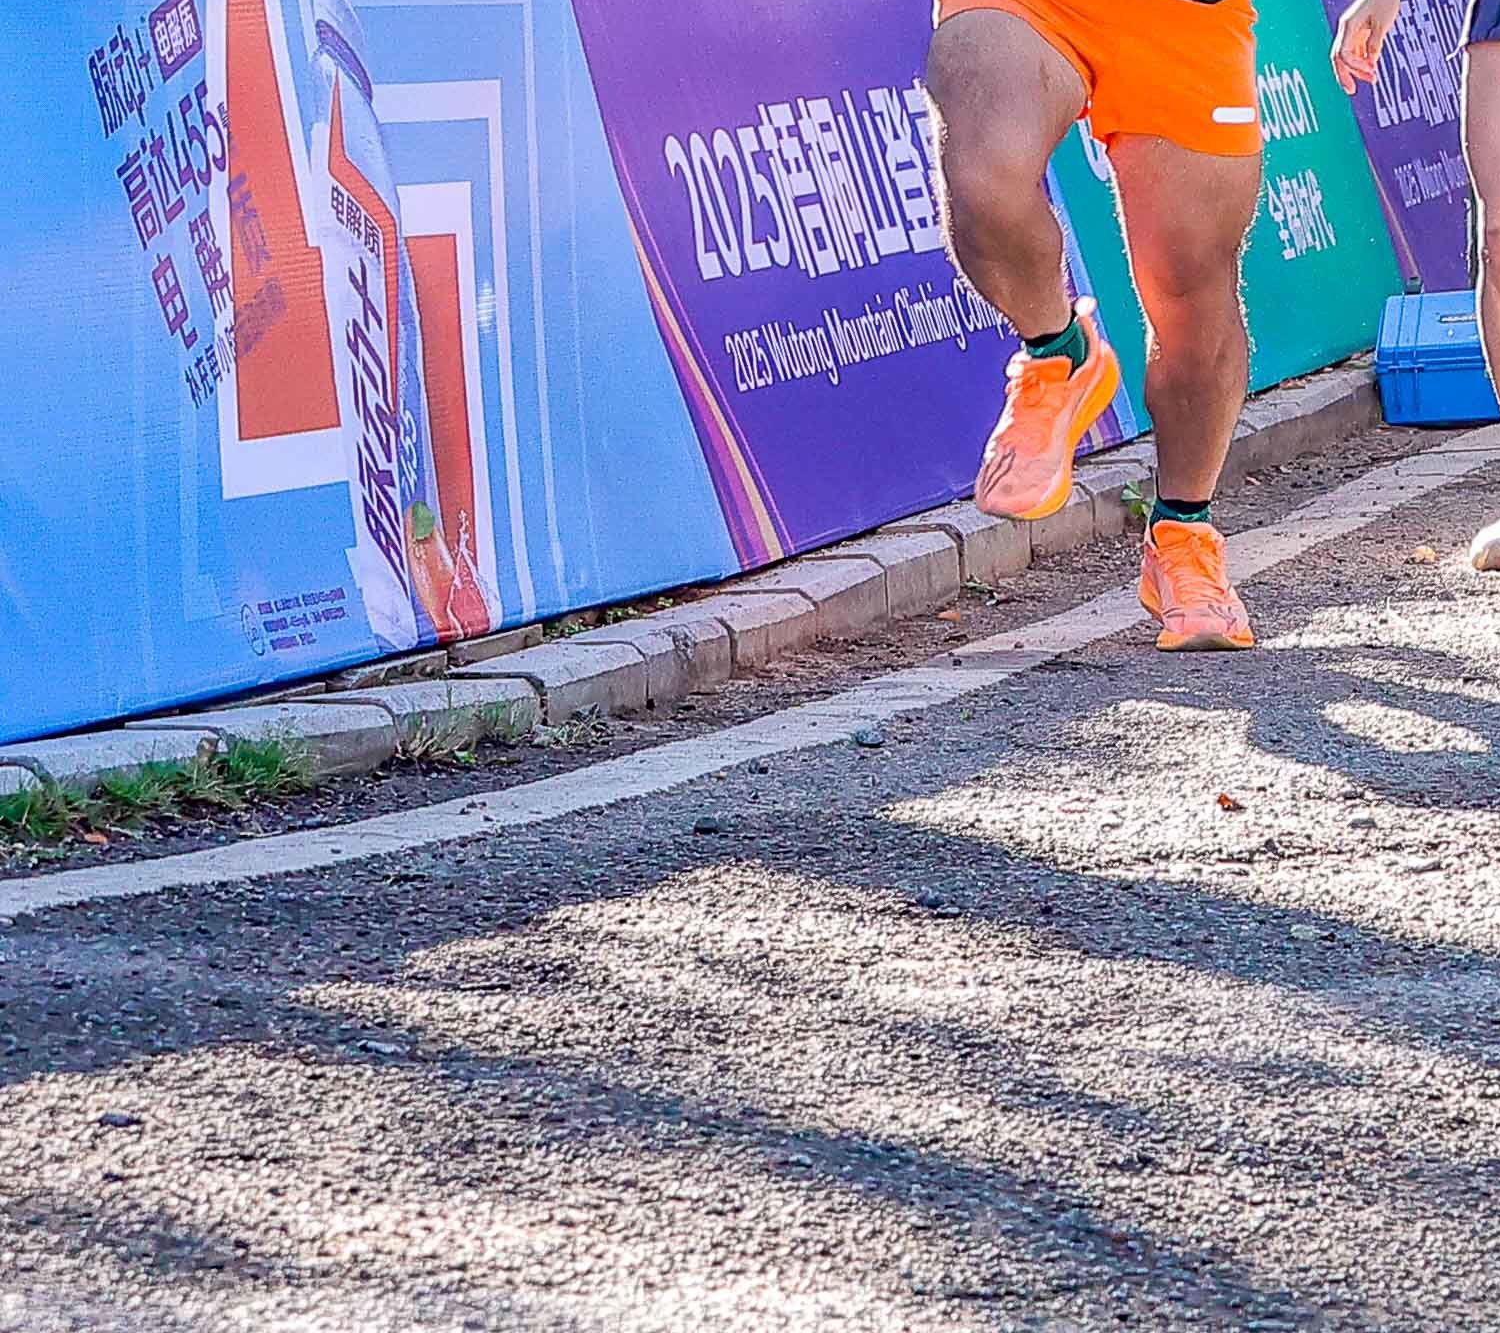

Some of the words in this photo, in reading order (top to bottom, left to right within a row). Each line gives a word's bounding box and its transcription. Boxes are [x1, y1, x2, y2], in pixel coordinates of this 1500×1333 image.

[724, 329, 772, 392] 2025
[768, 318, 834, 384] Wutong
[826, 295, 899, 379] Mountain
[895, 287, 962, 351] Climbing
